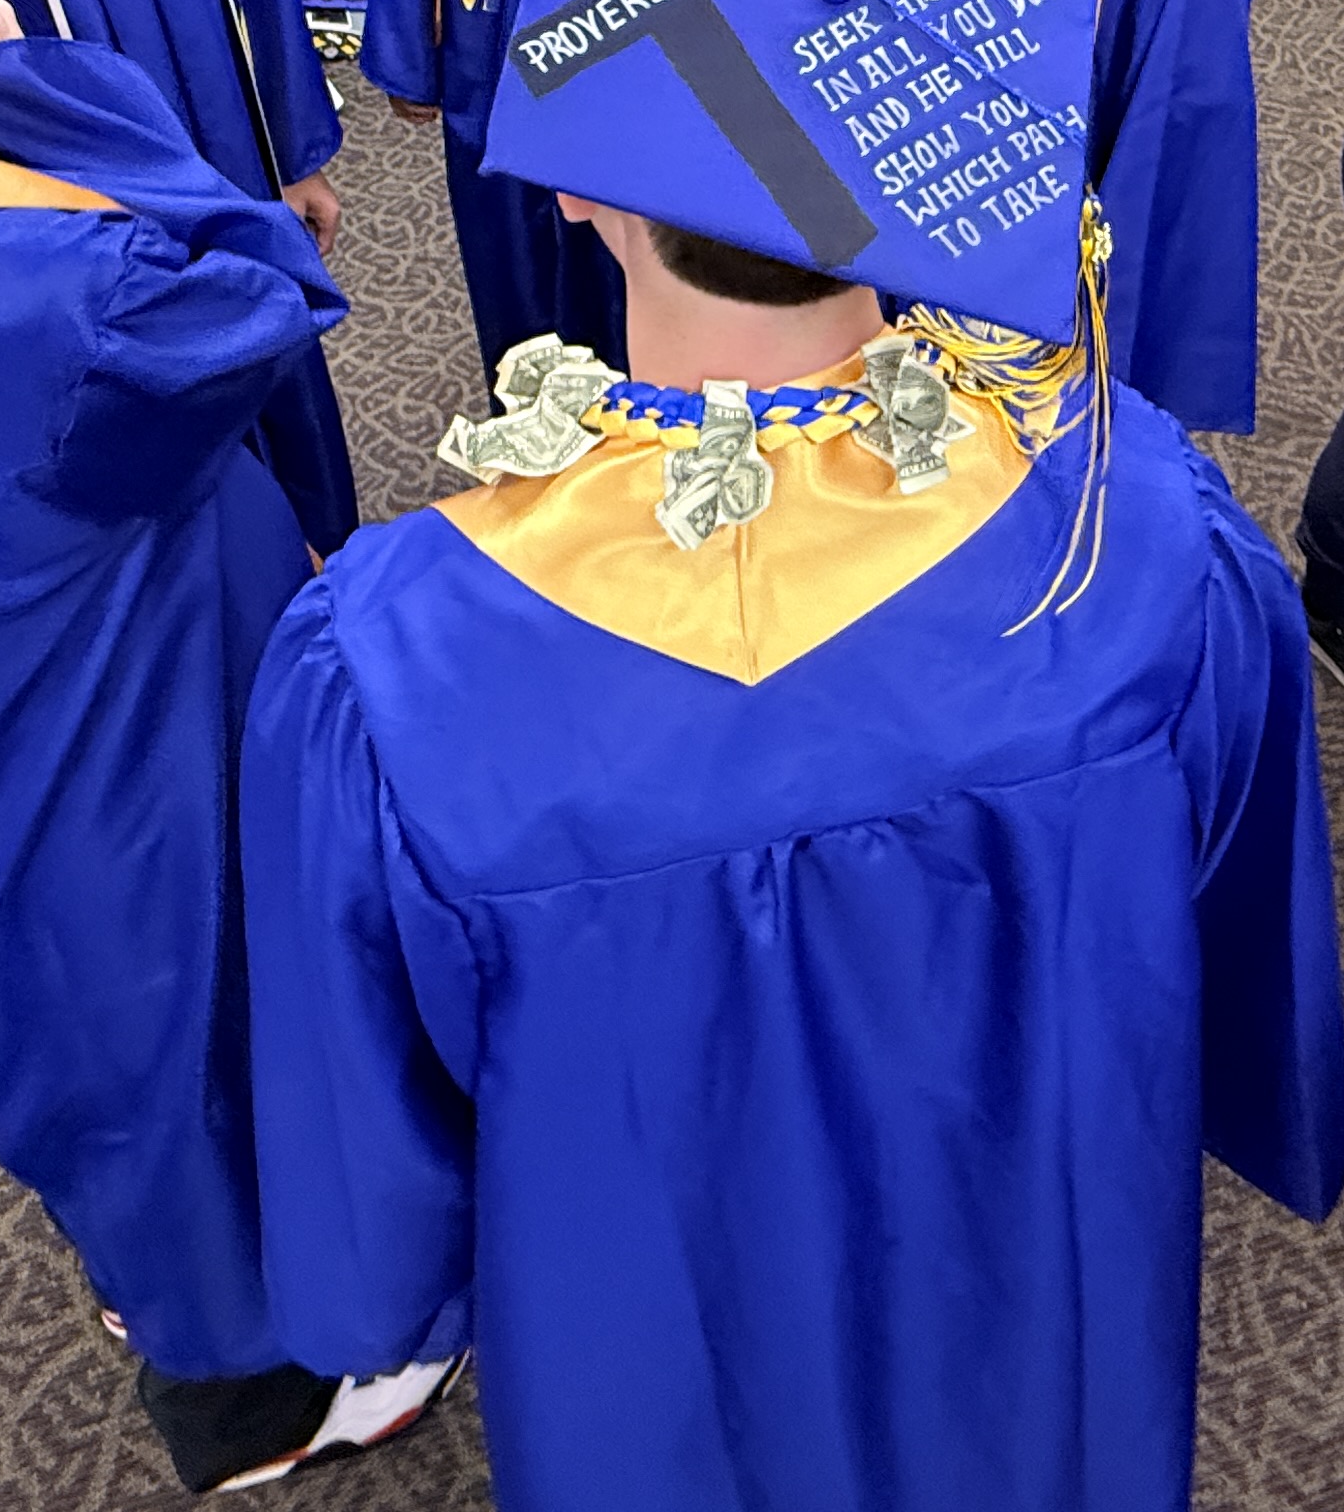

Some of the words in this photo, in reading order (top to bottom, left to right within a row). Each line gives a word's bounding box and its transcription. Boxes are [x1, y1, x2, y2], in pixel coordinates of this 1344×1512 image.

[792, 4, 884, 76] SEEK
[812, 67, 862, 113] IN
[856, 36, 928, 91] ALL
[843, 95, 912, 158] AND
[905, 62, 964, 114] HE
[872, 123, 962, 197] SHOW
[960, 92, 1030, 137] YOU
[894, 145, 1014, 228] WHICH
[927, 196, 983, 259] TO
[979, 163, 1071, 232] TAKE
